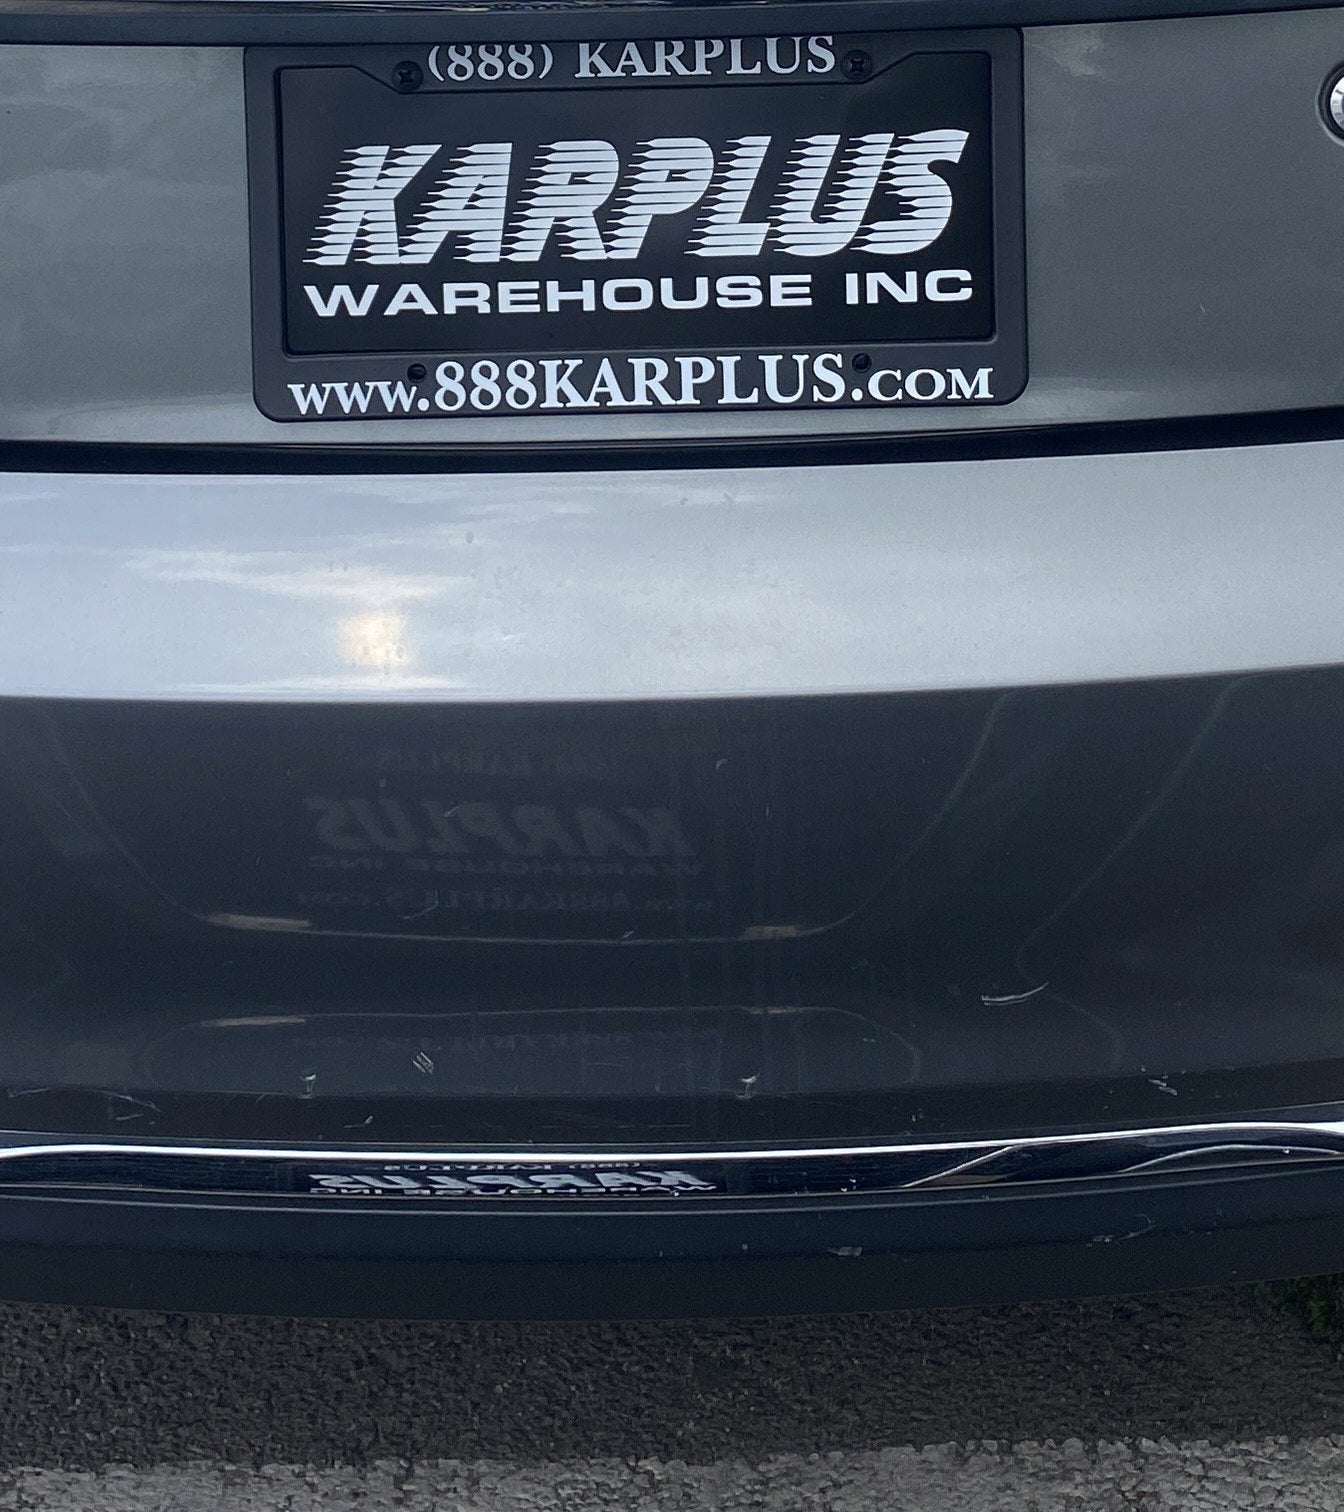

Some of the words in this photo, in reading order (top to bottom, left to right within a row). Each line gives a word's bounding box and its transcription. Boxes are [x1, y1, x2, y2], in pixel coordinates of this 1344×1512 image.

[427, 43, 553, 82] (888)
[573, 35, 837, 79] KARPLUS
[302, 128, 970, 266] KARPLUS
[303, 272, 814, 317] WAREHOUSE
[845, 268, 974, 306] INC
